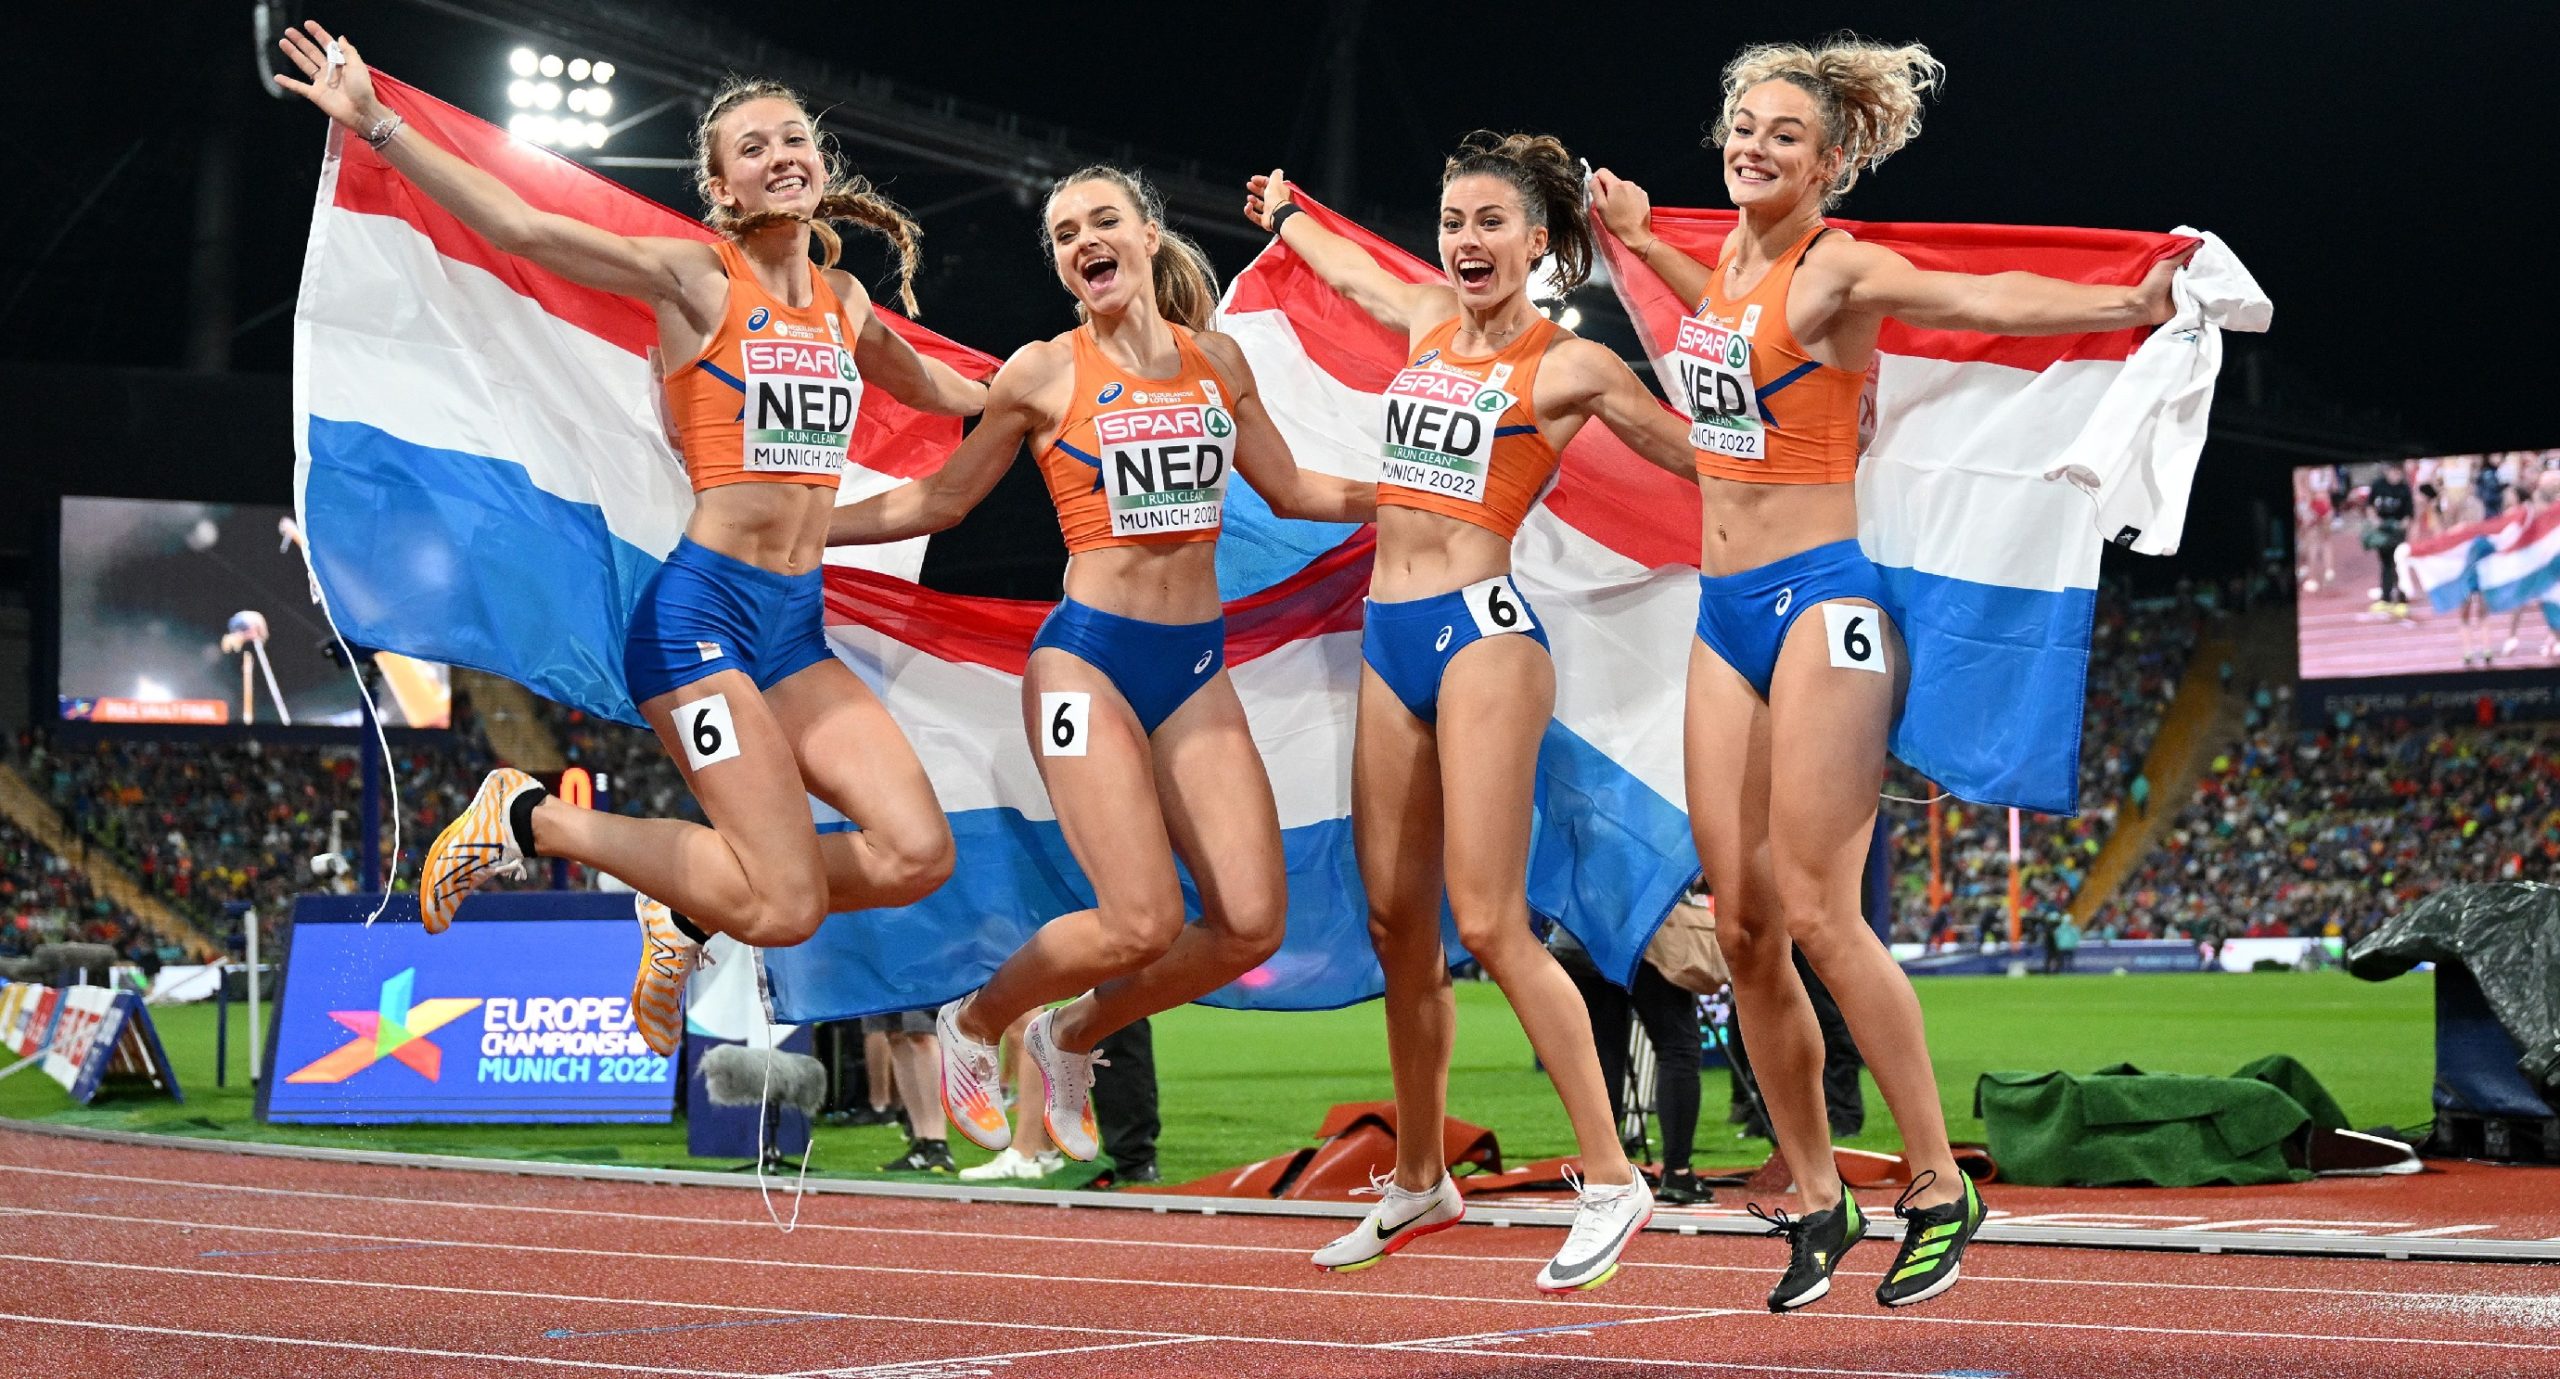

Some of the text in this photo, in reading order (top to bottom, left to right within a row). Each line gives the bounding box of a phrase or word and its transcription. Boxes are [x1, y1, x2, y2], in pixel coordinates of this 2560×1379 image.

[1679, 325, 1727, 361] SPAR
[749, 346, 836, 373] SPAR
[1393, 374, 1477, 402] SPAR
[1680, 359, 1747, 416] NED
[757, 381, 852, 433] NED
[788, 431, 809, 442] RUN
[811, 433, 836, 445] CLEAN
[1103, 411, 1200, 439] SPAR
[1386, 398, 1481, 457] NED
[1397, 448, 1417, 460] RUN
[1720, 432, 1755, 453] 2022
[754, 447, 821, 468] MUNICH
[1114, 444, 1224, 496] NED
[1429, 470, 1476, 496] 2022
[1148, 494, 1175, 505] RUN
[1119, 505, 1218, 530] MUNICH 2022
[1488, 585, 1517, 628] 6
[1843, 616, 1872, 662] 6
[693, 708, 722, 756] 6
[1052, 701, 1075, 748] 6
[477, 1056, 668, 1083] MUNICH 2022
